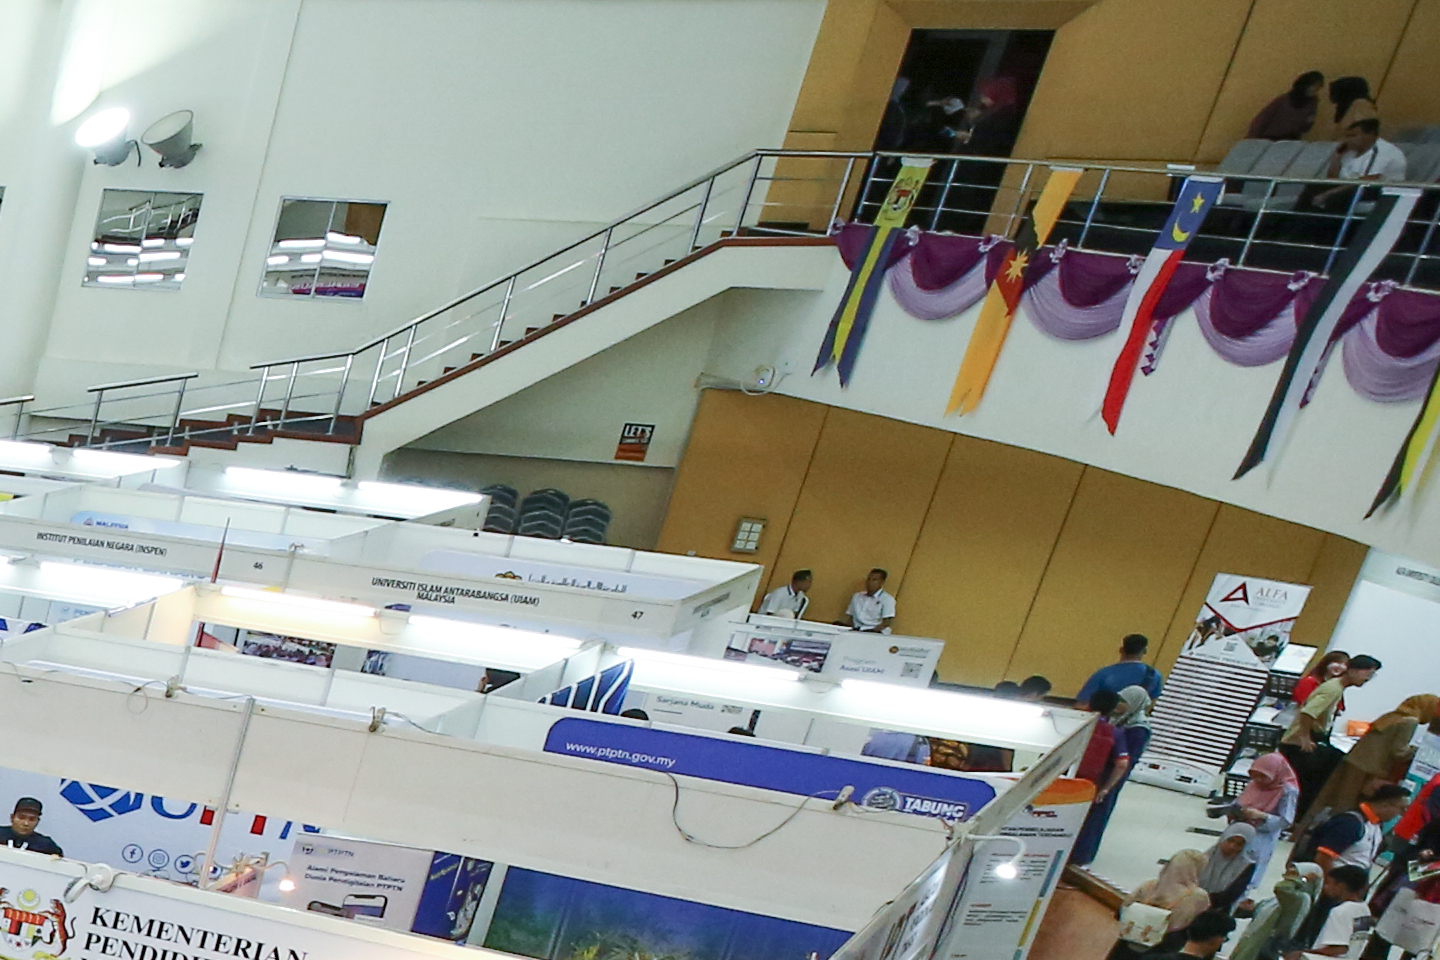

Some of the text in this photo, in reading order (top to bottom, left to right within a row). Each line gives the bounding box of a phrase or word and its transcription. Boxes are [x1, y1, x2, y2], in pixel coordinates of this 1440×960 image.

[36, 531, 168, 560] INSTITUT PENILAIAN NEGARA (INSPEN)
[371, 576, 540, 608] UNIVERSITI ISLAM ANTARABANGSA (UIAM)
[416, 592, 456, 605] MALAYSIA
[631, 610, 644, 621] 47
[566, 740, 677, 768] www.ptptn.gov.my
[904, 797, 966, 820] TABUNG
